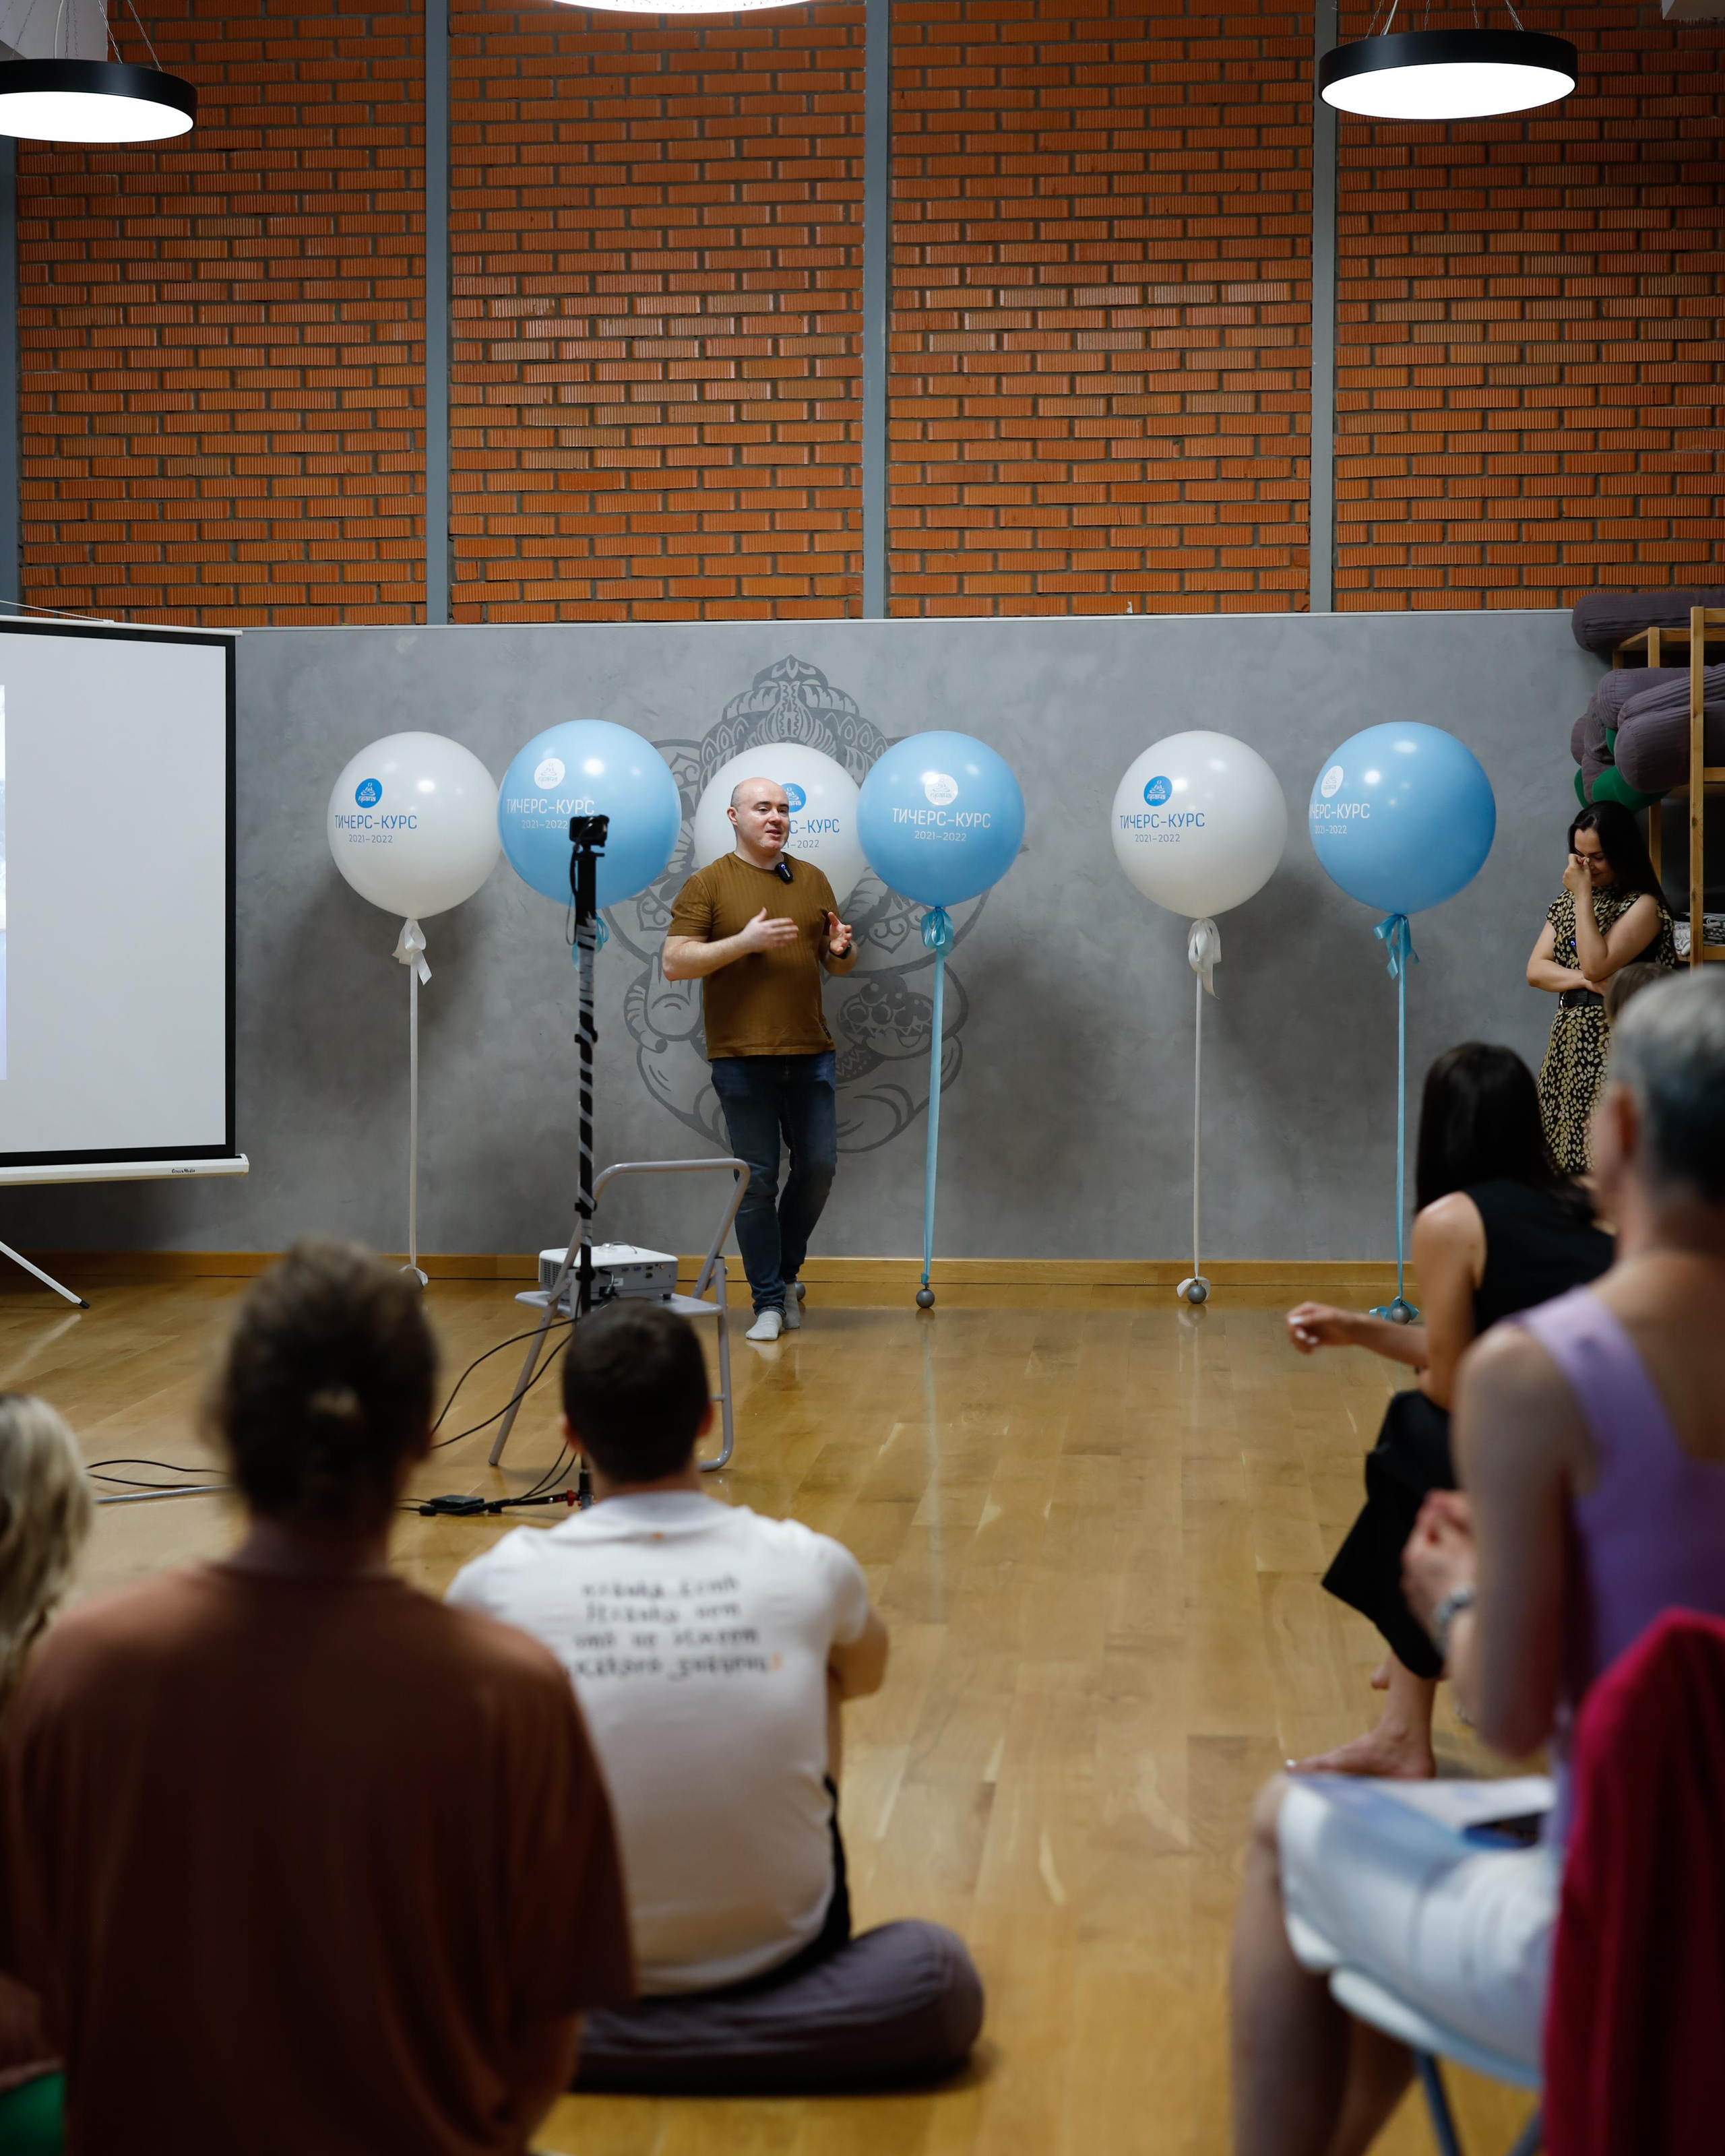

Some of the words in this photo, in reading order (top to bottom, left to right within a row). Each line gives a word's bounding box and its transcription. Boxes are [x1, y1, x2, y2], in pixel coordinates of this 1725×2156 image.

[507, 798, 595, 815] ТИЧЕРС-КУРС
[335, 815, 417, 829] ТИЧЕРС-КУРС
[522, 819, 568, 829] 2021-2022
[893, 808, 991, 828] ТИЧЕРС-КУРС
[1120, 813, 1205, 829] ТИЧЕРС-КУРС
[789, 819, 840, 834] С-КУРС
[349, 834, 393, 843] 2021-2022
[914, 830, 967, 842] 2021-2022
[1135, 833, 1181, 843] 2021-2022
